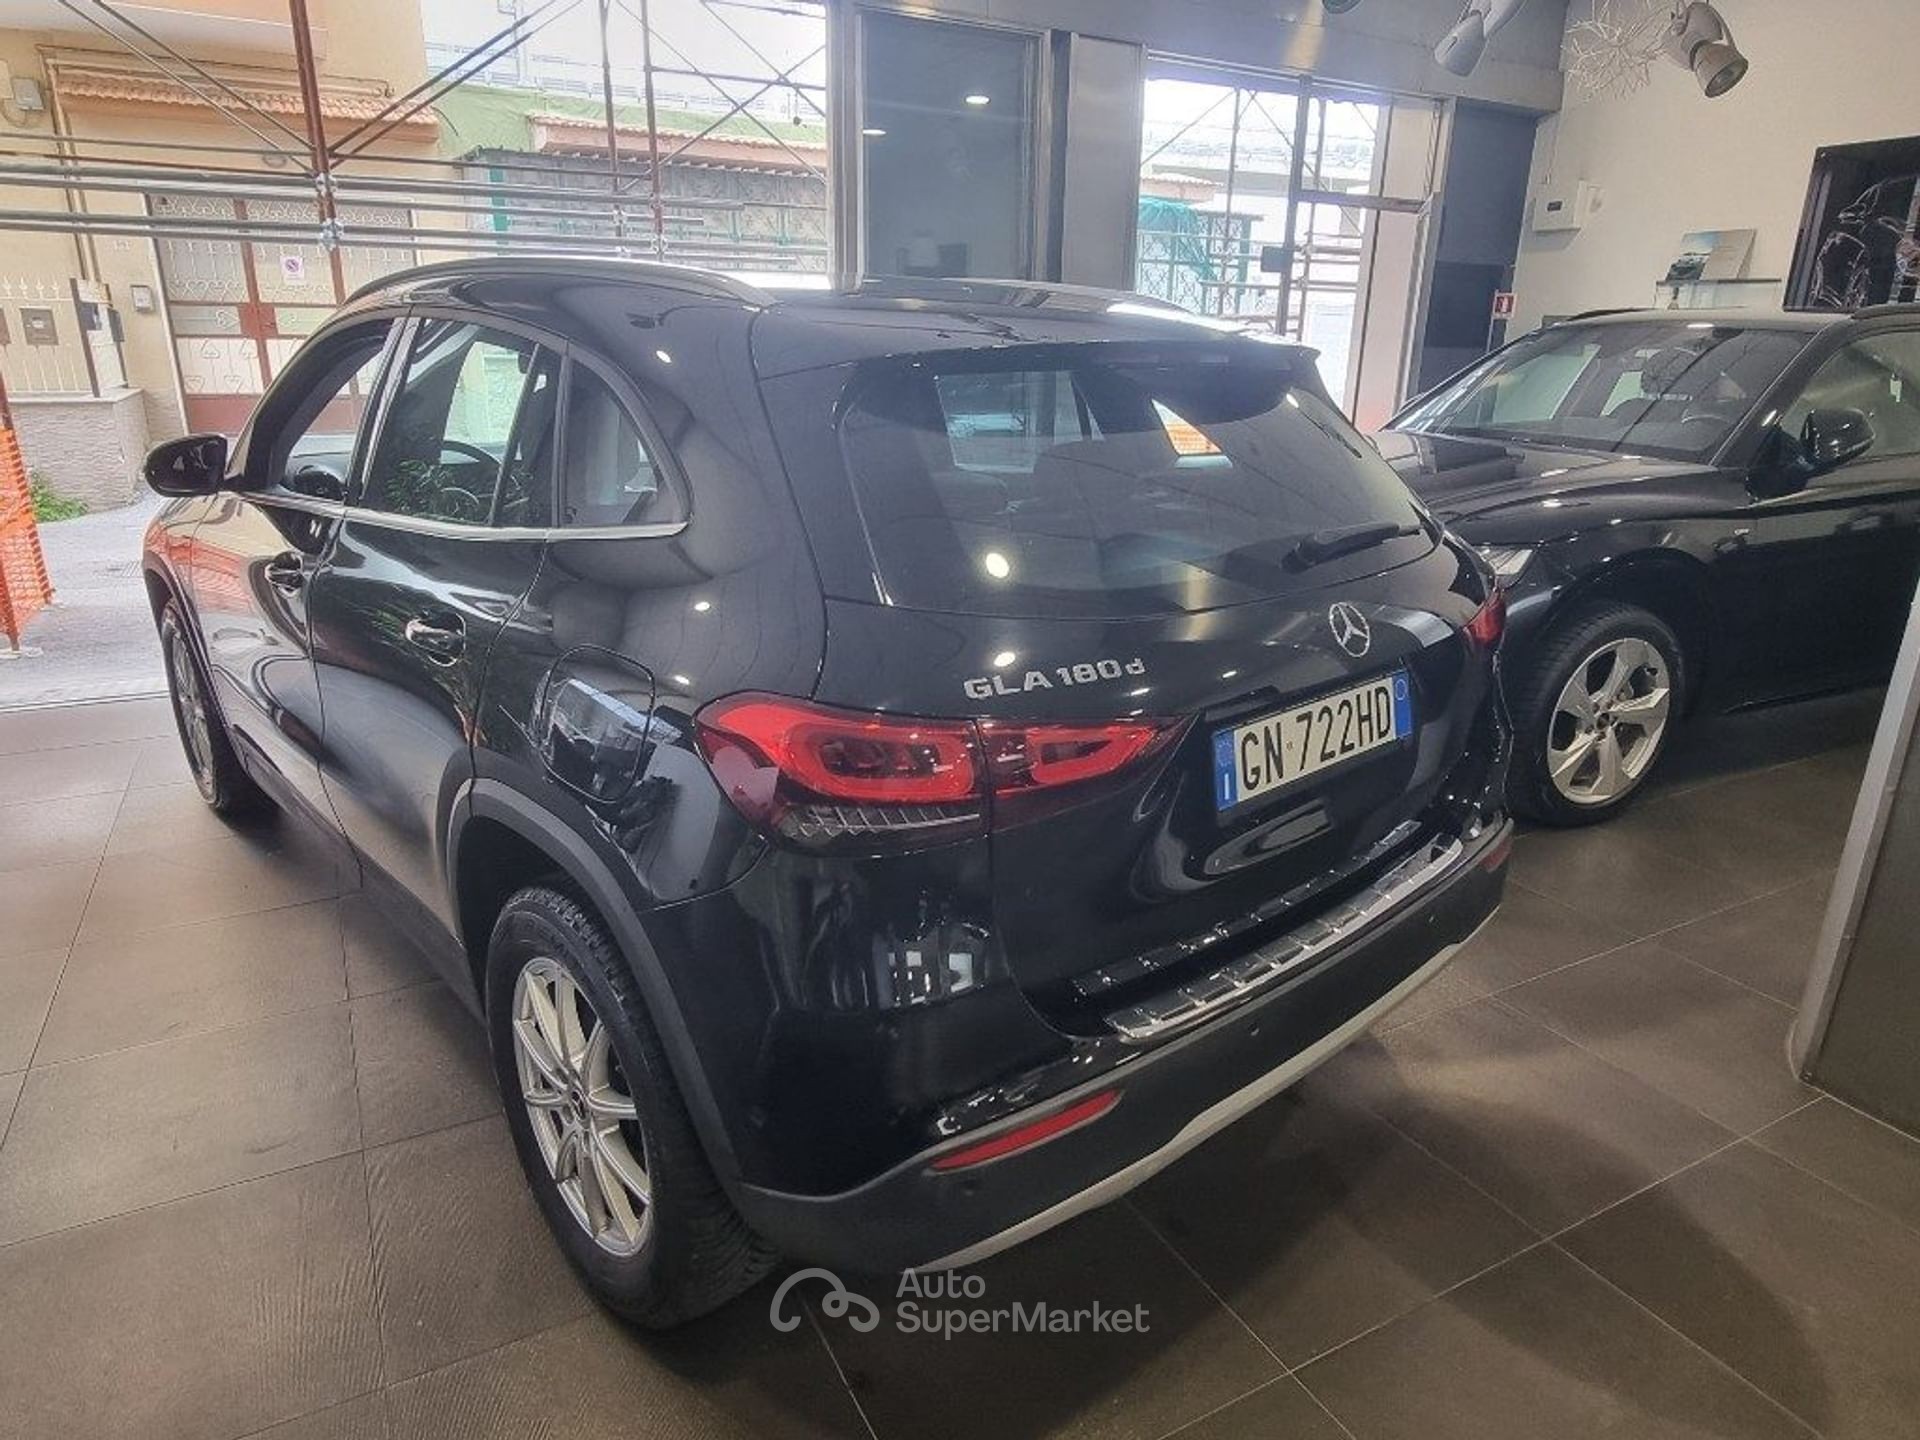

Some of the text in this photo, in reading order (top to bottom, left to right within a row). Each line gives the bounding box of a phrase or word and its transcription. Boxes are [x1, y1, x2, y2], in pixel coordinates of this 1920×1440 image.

[963, 671, 1053, 699] GLA
[1240, 721, 1285, 791] GN
[1295, 686, 1392, 772] 722HD
